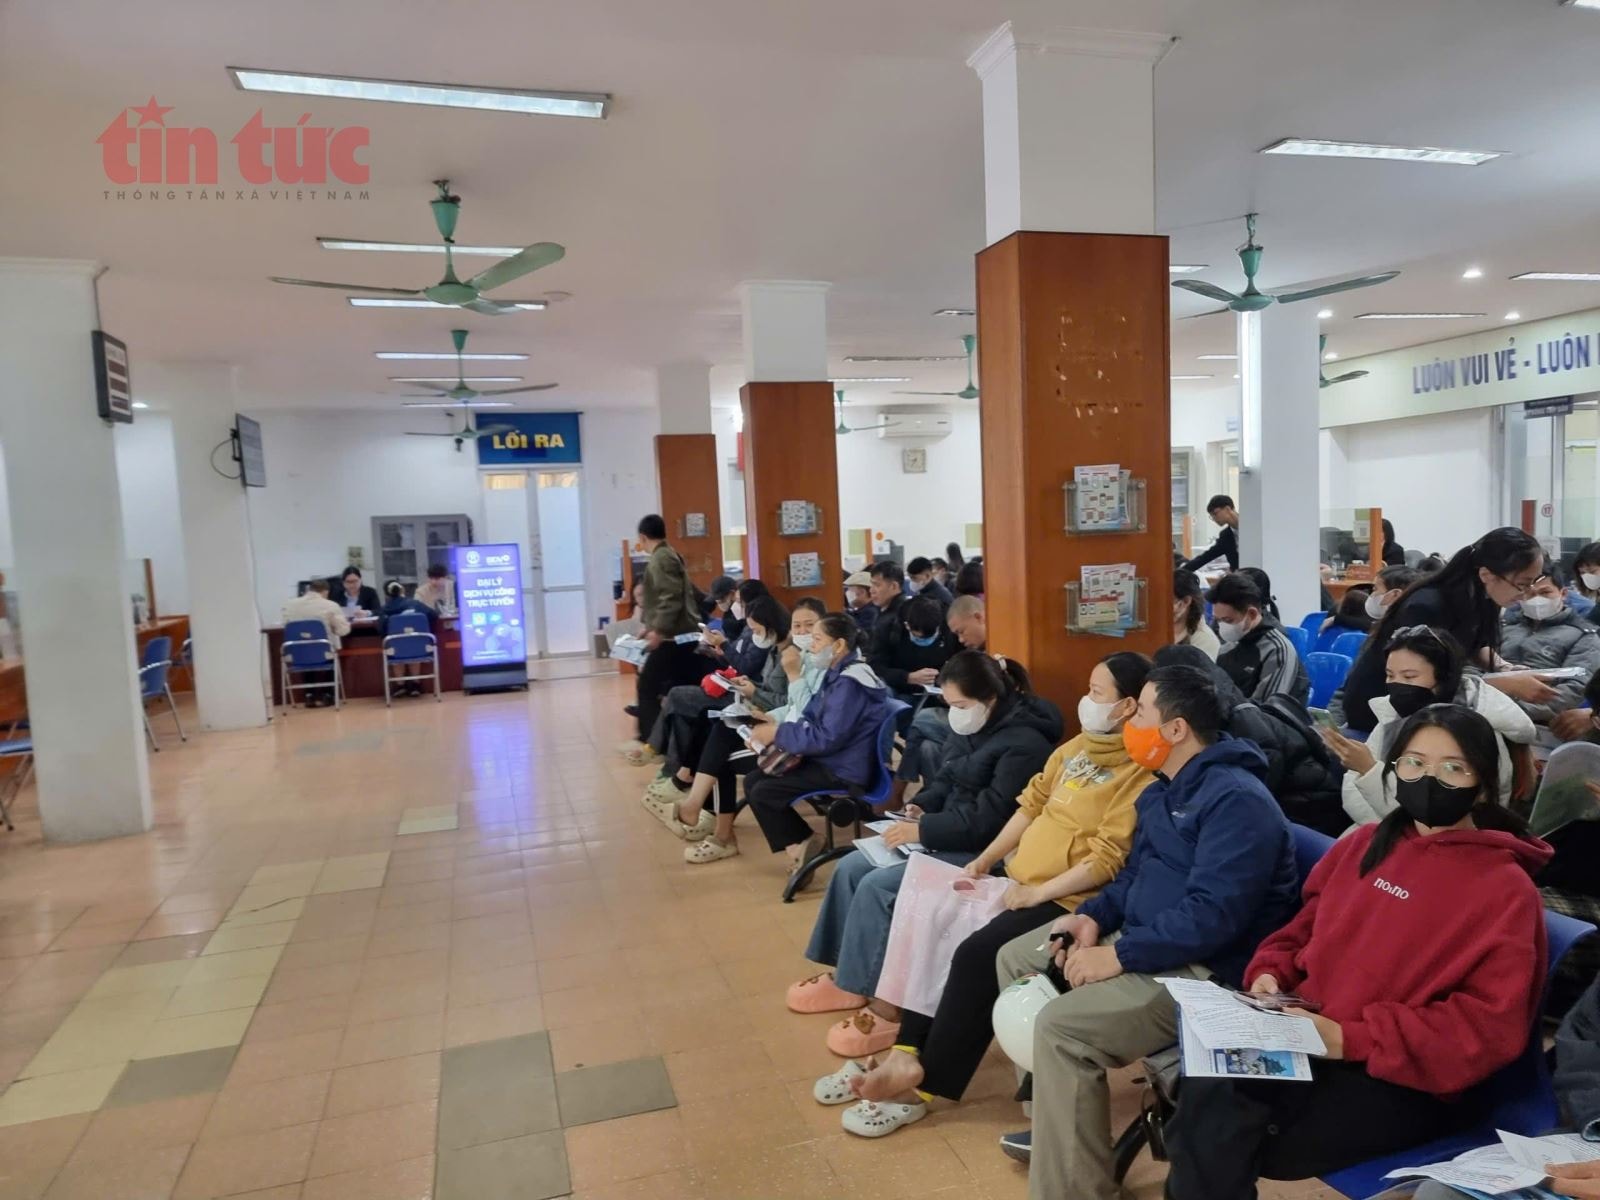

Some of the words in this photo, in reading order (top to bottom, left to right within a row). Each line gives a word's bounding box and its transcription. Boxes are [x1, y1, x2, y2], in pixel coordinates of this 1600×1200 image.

[1413, 356, 1456, 394] LUÔN
[1460, 353, 1489, 386] VUI
[1494, 336, 1517, 381] VẺ
[1537, 332, 1590, 375] LUÔN
[492, 429, 528, 450] LỐI
[534, 433, 565, 448] RA
